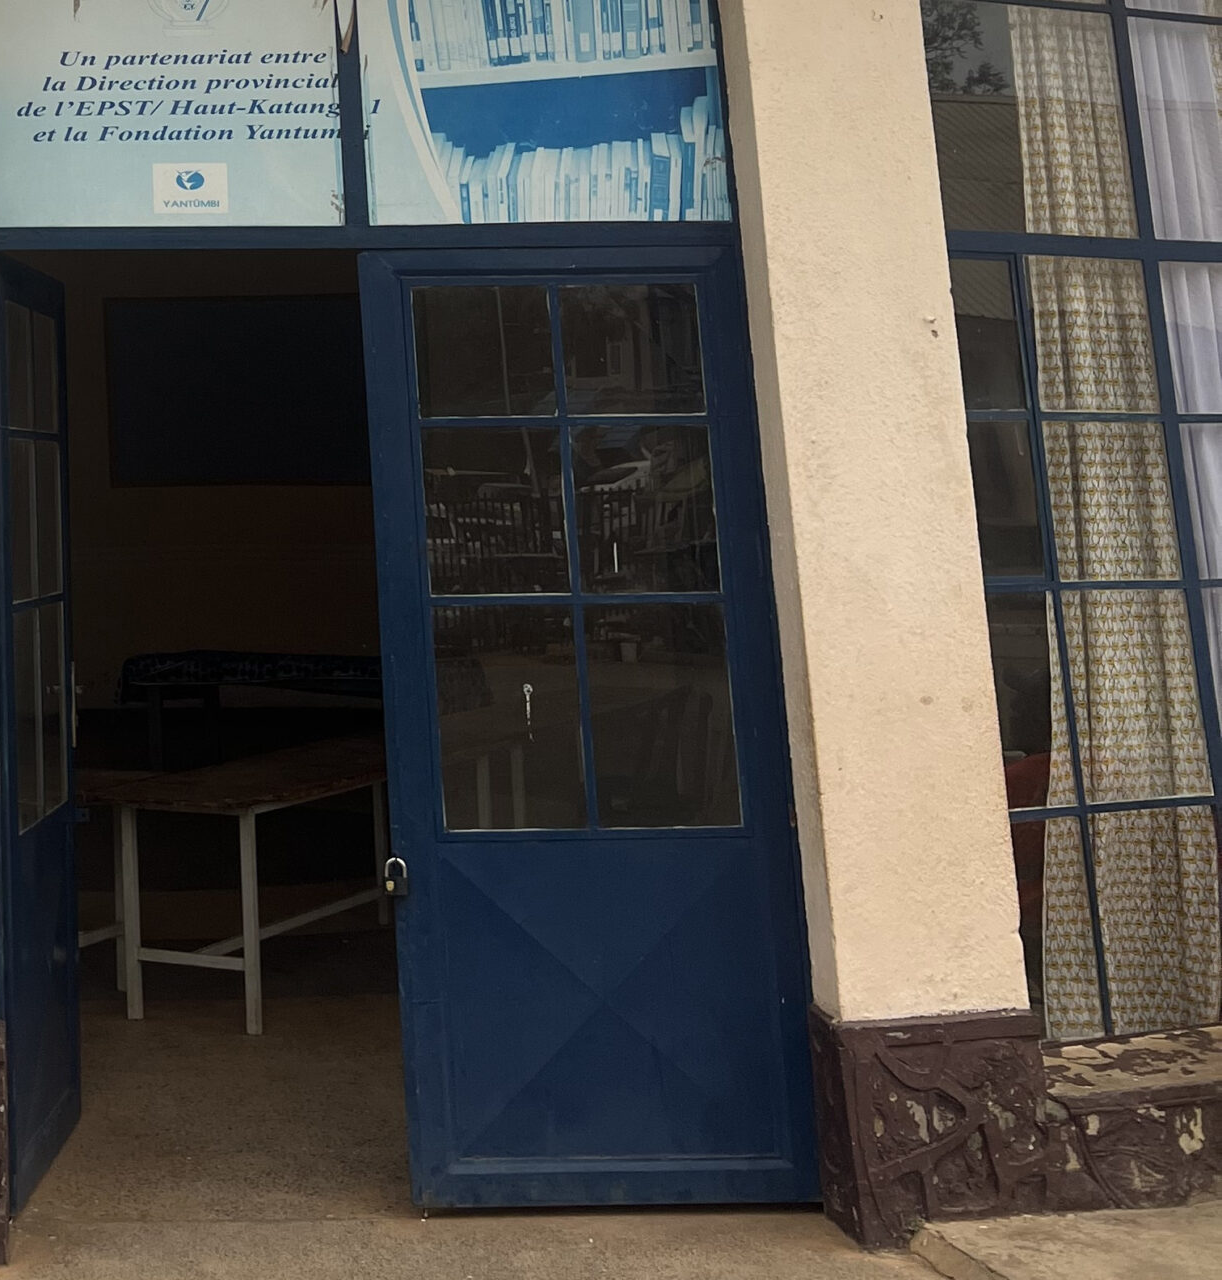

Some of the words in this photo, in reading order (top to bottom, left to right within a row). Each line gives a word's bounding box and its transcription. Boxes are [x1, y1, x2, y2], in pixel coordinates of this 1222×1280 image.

[59, 50, 96, 67] Un
[103, 49, 253, 71] partenariat
[260, 50, 327, 64] entre
[42, 76, 67, 92] la
[75, 74, 197, 92] Direction
[204, 73, 338, 95] provincial
[16, 101, 47, 118] de
[168, 99, 340, 118] Haut-Katang
[32, 128, 57, 143] et
[63, 126, 88, 142] la
[98, 124, 234, 142] Fondation
[245, 123, 371, 140] Yantumi
